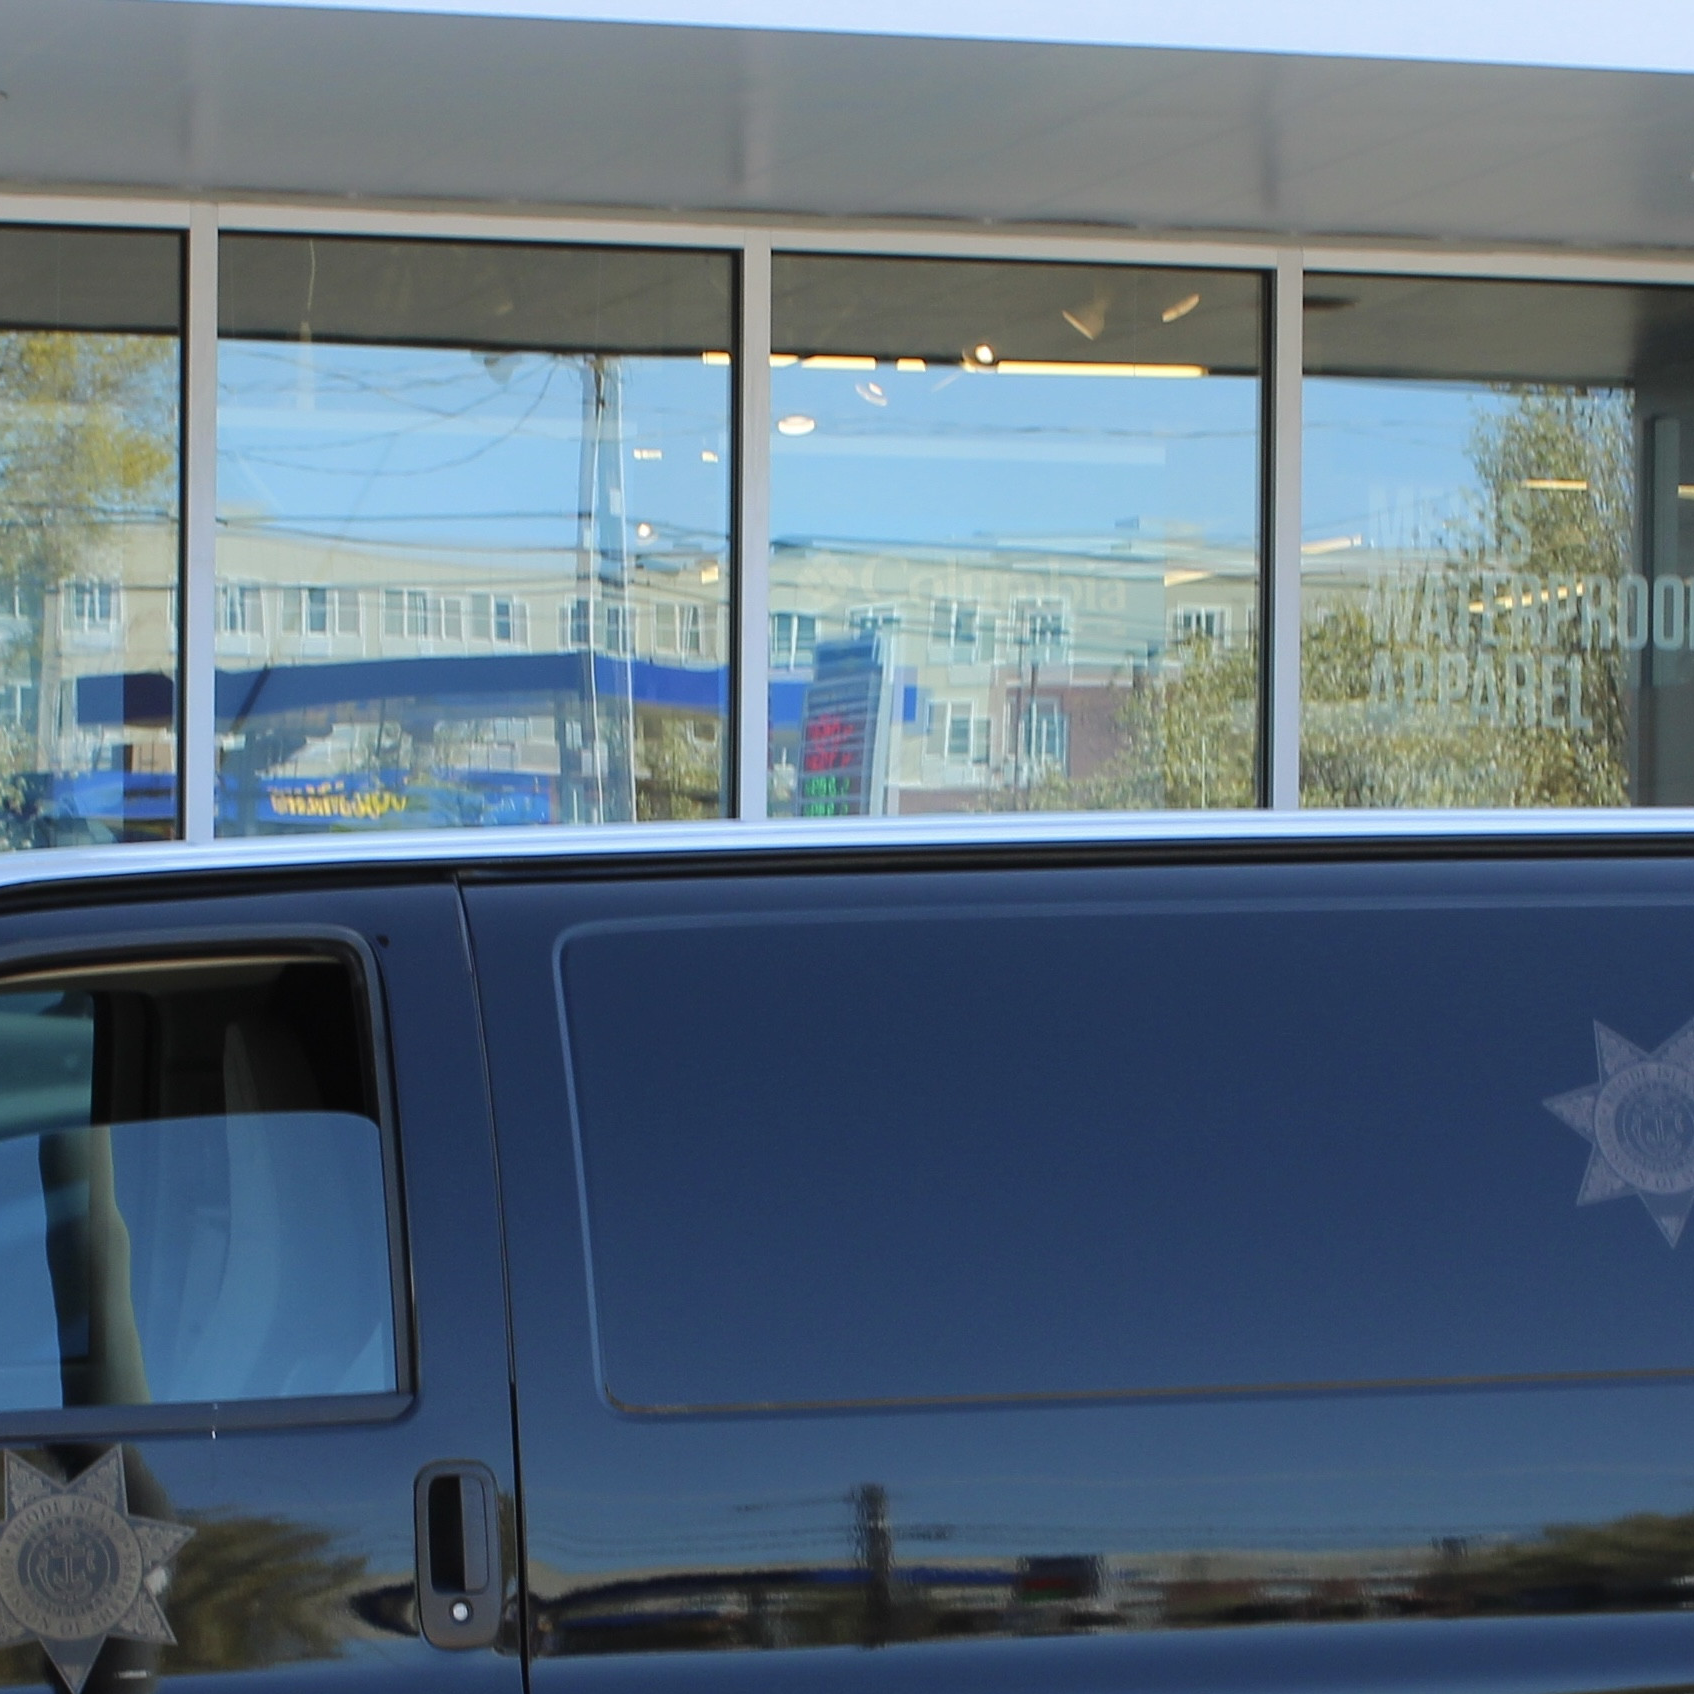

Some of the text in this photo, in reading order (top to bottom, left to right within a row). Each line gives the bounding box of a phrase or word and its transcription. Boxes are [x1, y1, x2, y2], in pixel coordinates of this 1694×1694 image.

[857, 553, 1128, 613] Columbia
[1368, 651, 1594, 731] APPAREL
[7, 1501, 59, 1544] RHODE
